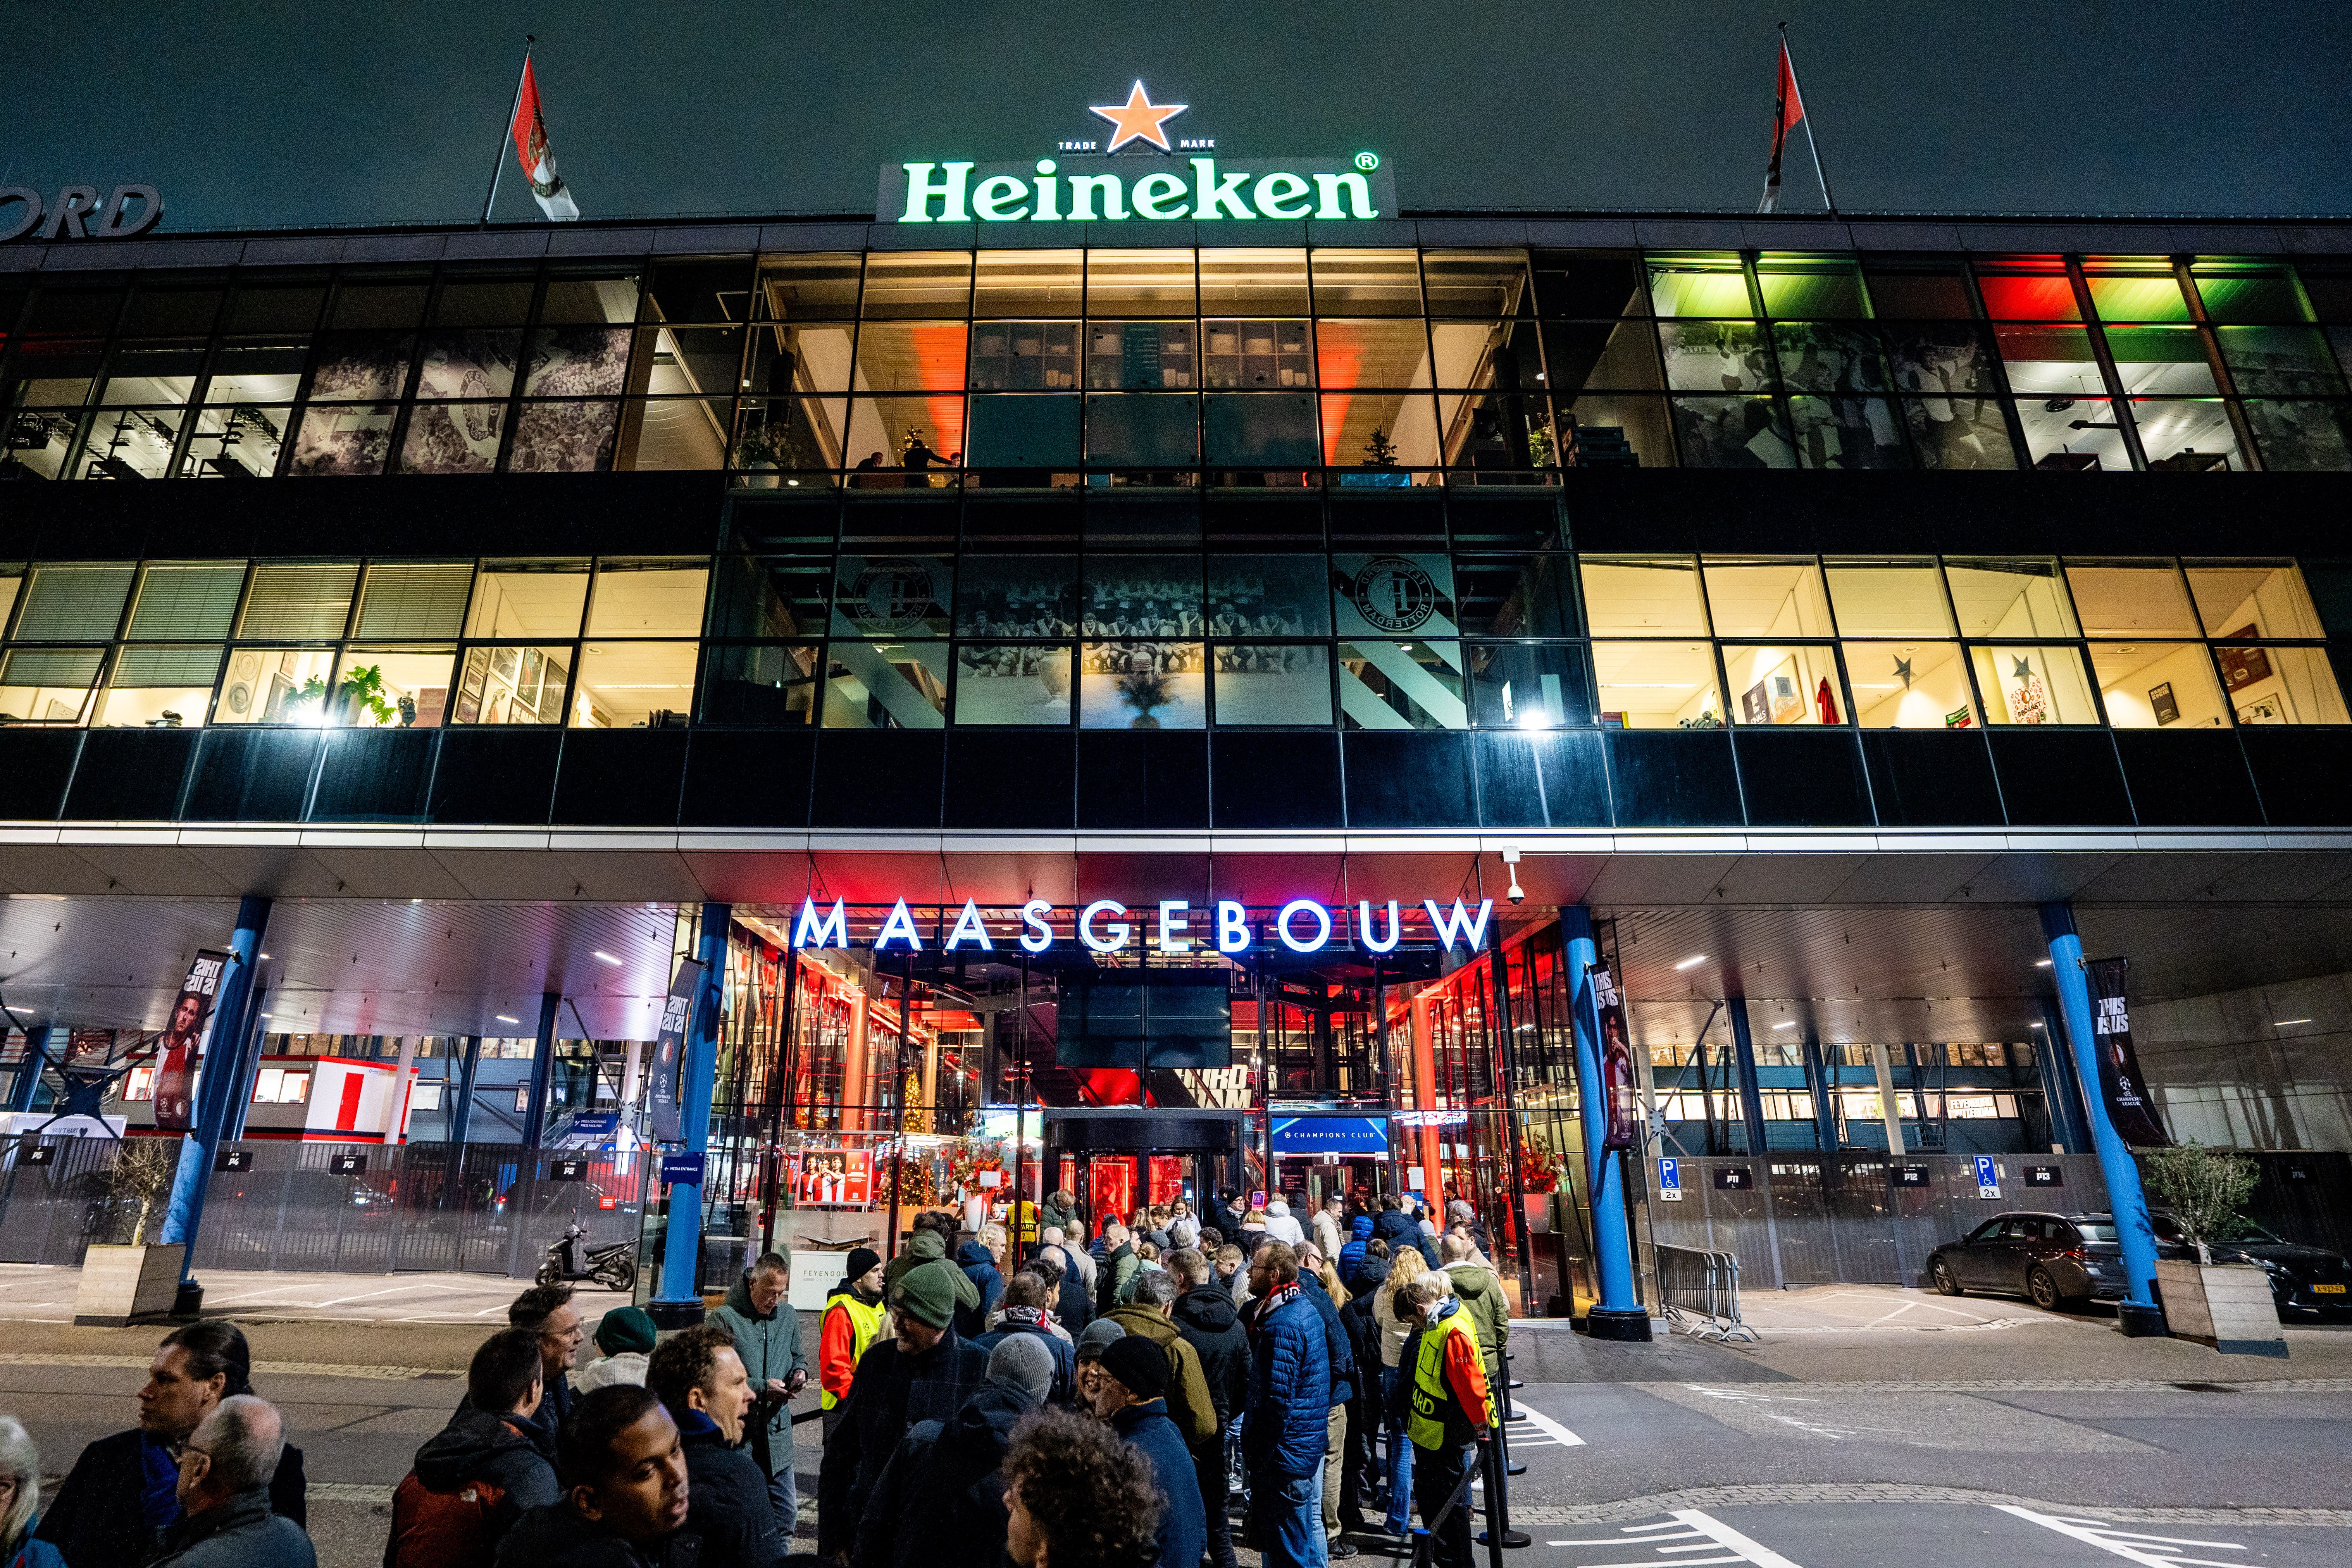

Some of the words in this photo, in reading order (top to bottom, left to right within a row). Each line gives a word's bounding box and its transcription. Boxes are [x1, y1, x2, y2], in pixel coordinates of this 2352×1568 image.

[1058, 141, 1096, 150] TRADE
[1180, 140, 1215, 148] MARK
[898, 158, 1379, 222] Heineken
[793, 895, 1493, 952] MAASGEBOUW
[1594, 971, 1612, 991] THIS
[1596, 991, 1606, 1010] IS
[1604, 988, 1618, 1006] US
[2099, 996, 2125, 1017] THIS
[2097, 1016, 2112, 1034] IS
[2111, 1014, 2129, 1033] US
[1662, 1160, 1674, 1176] P
[1978, 1158, 1990, 1174] P
[1984, 1189, 1996, 1198] 2x
